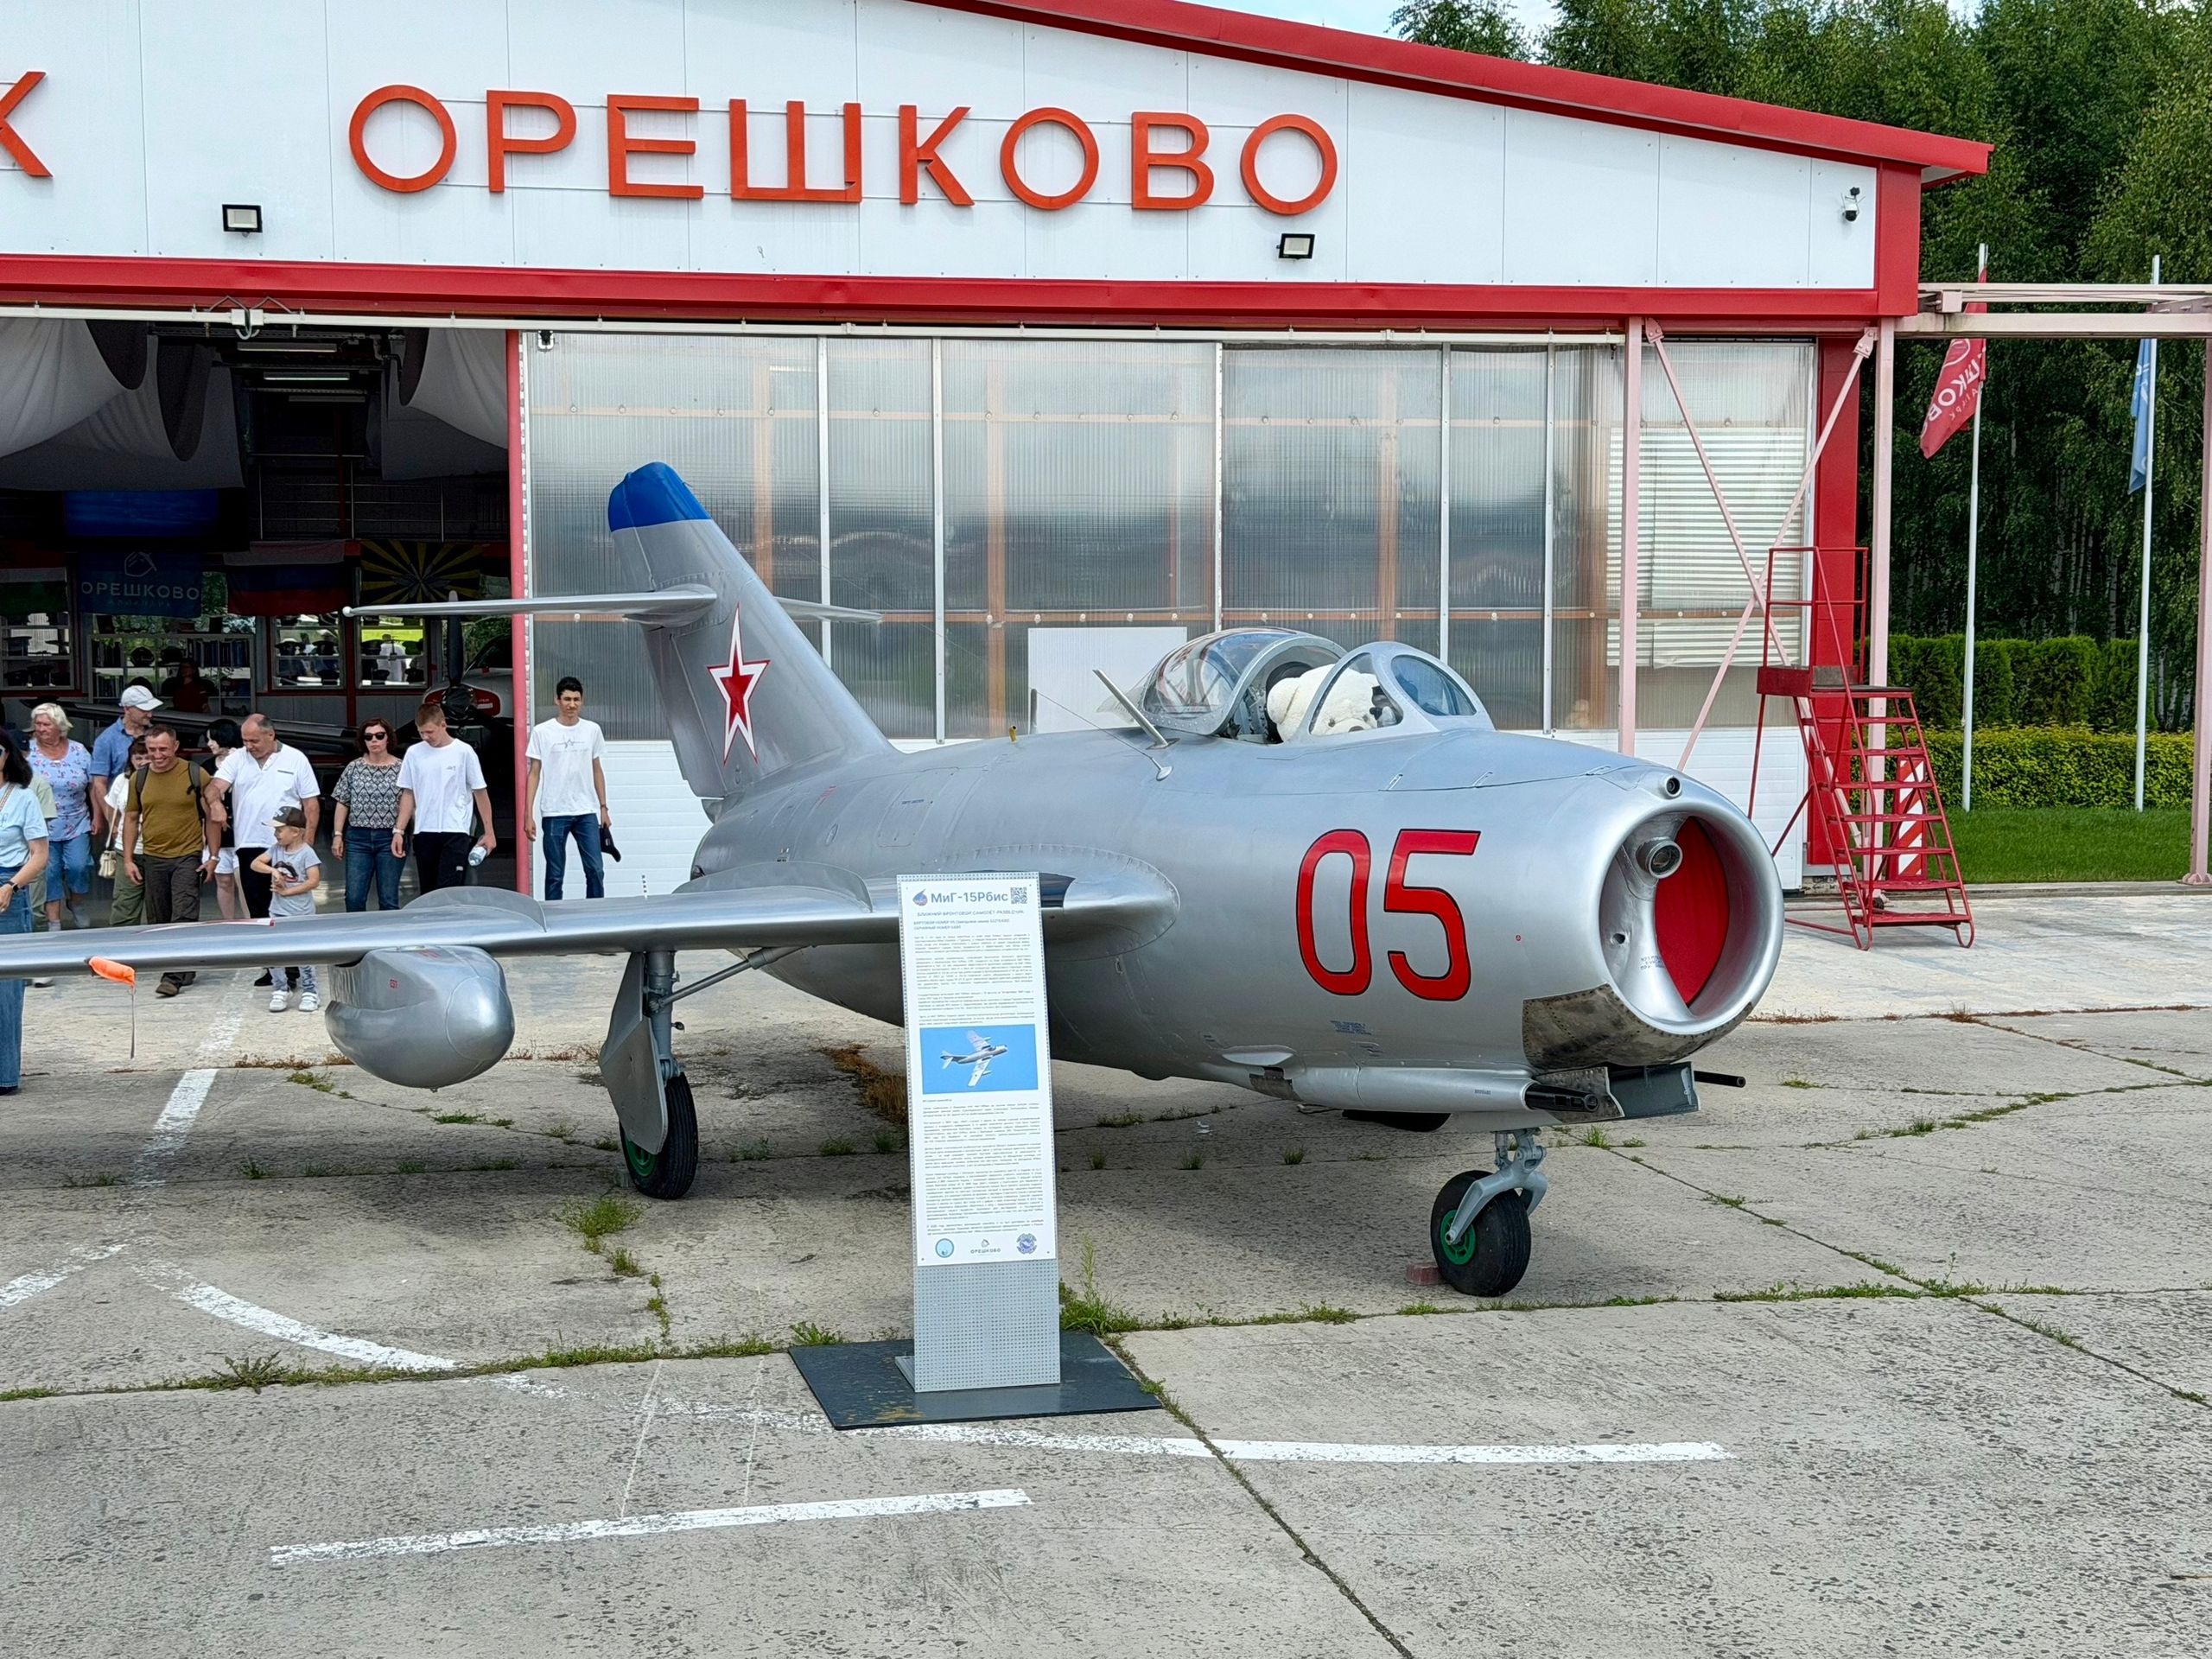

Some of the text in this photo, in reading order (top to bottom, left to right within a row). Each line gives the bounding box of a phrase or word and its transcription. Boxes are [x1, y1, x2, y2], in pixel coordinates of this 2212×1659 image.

[349, 85, 1338, 215] ОРЕШКОВО
[81, 582, 200, 600] ОРЕШКОВО
[931, 892, 1008, 903] МиГ-15Рбис
[1296, 829, 1481, 1001] 05
